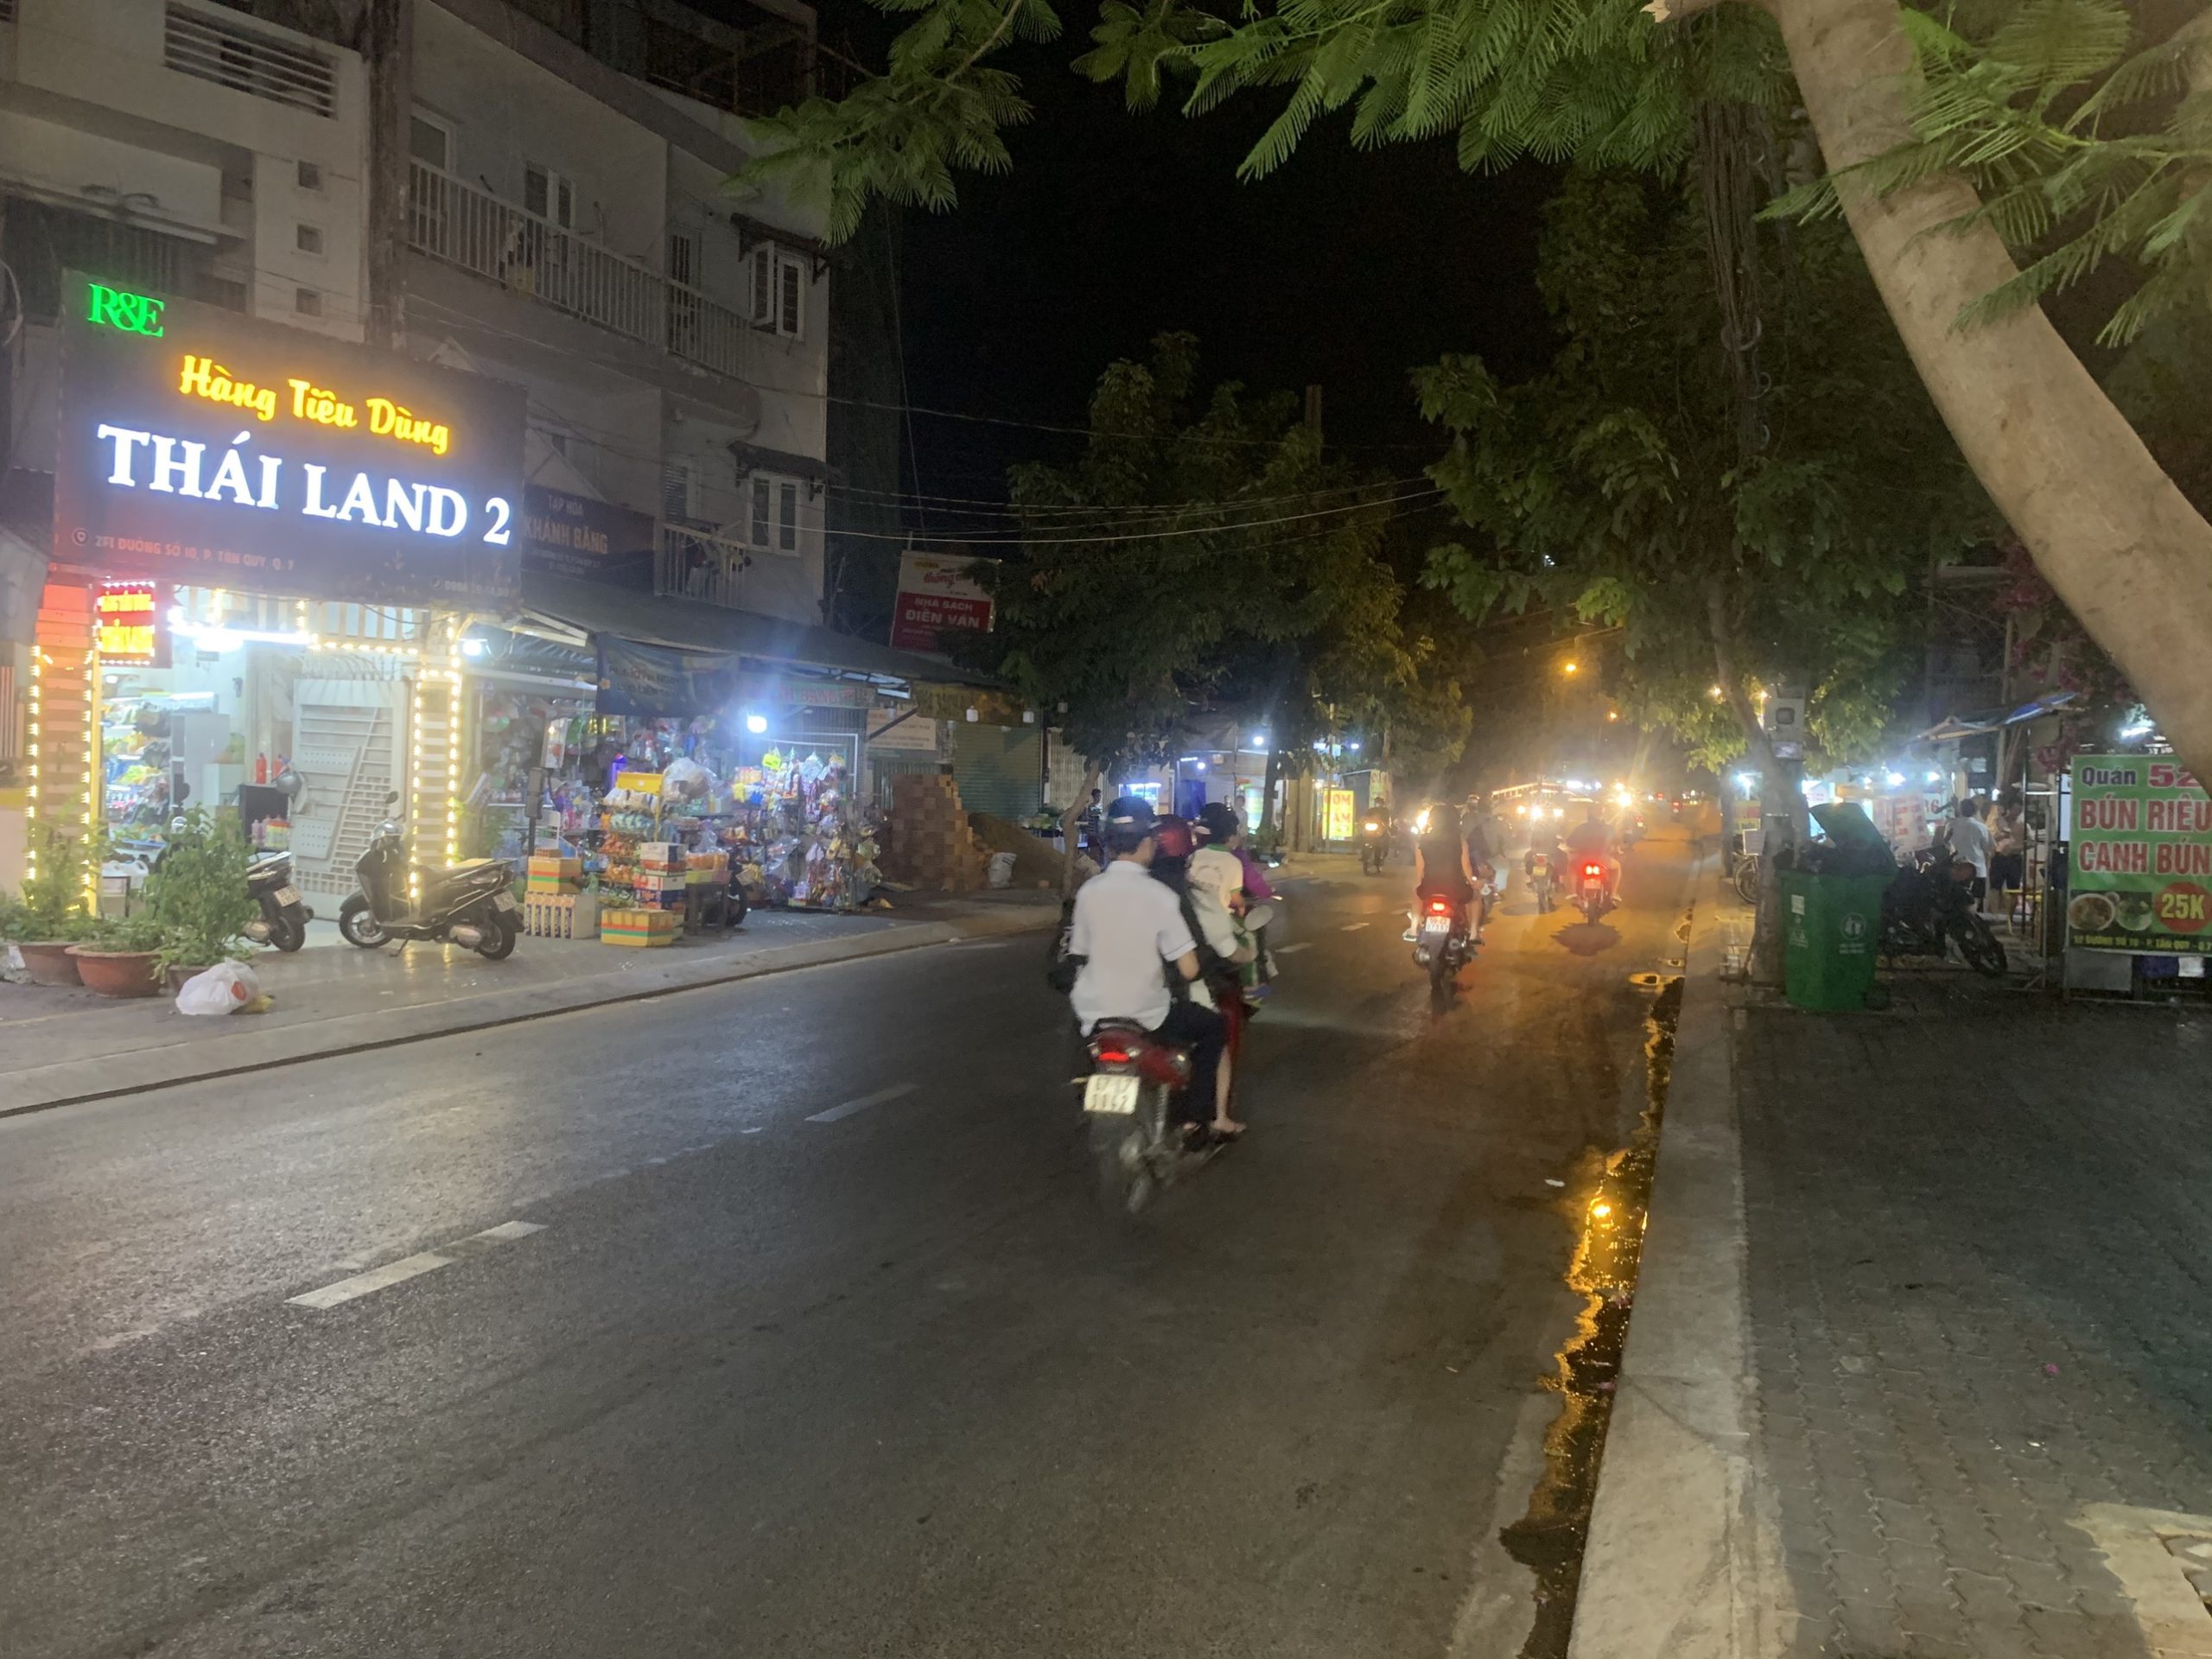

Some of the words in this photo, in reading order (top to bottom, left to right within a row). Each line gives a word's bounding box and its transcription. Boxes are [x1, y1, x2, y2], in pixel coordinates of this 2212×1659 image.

[88, 283, 165, 338] R&E
[180, 354, 277, 422] Hàng
[288, 378, 357, 428] Tiêu
[365, 397, 450, 455] Dùng
[97, 423, 283, 510] THÁI
[302, 462, 468, 537] LAND
[483, 496, 512, 546] 2
[2081, 767, 2137, 786] Quán
[2080, 792, 2138, 830] BÚN
[2147, 794, 2212, 831] RIÊU
[2079, 841, 2148, 873] CANH
[2156, 836, 2212, 874] BÚN
[2161, 894, 2206, 920] 25K
